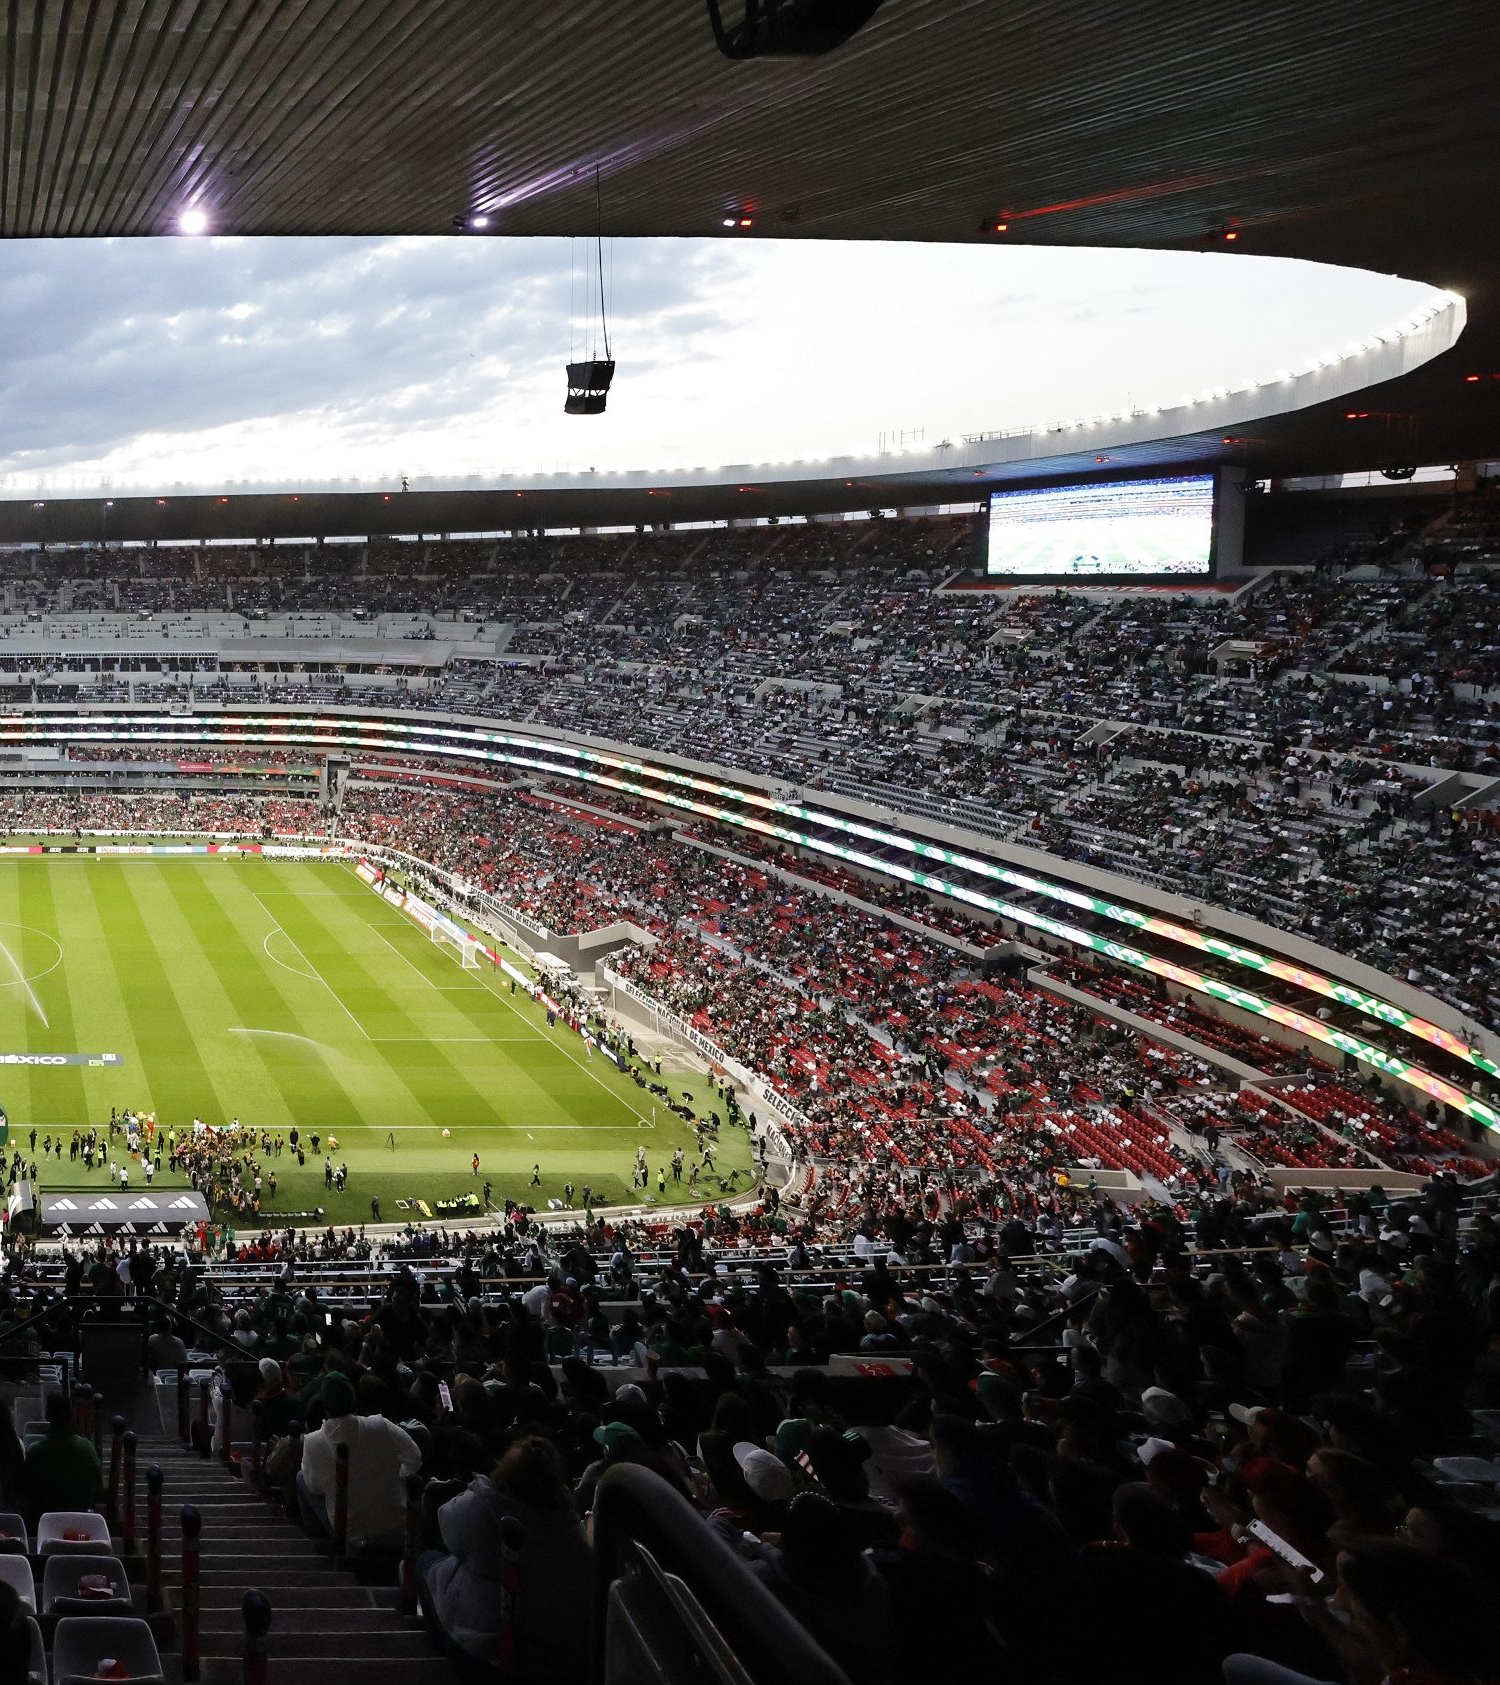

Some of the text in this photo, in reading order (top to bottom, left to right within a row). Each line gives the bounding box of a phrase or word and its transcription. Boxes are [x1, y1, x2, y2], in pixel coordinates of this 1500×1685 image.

[492, 897, 515, 918] NACIONAL
[522, 913, 541, 933] MÉXICO
[689, 1030, 699, 1043] DE
[699, 1038, 725, 1064] MÉXICO
[762, 1088, 797, 1122] SELECCI
